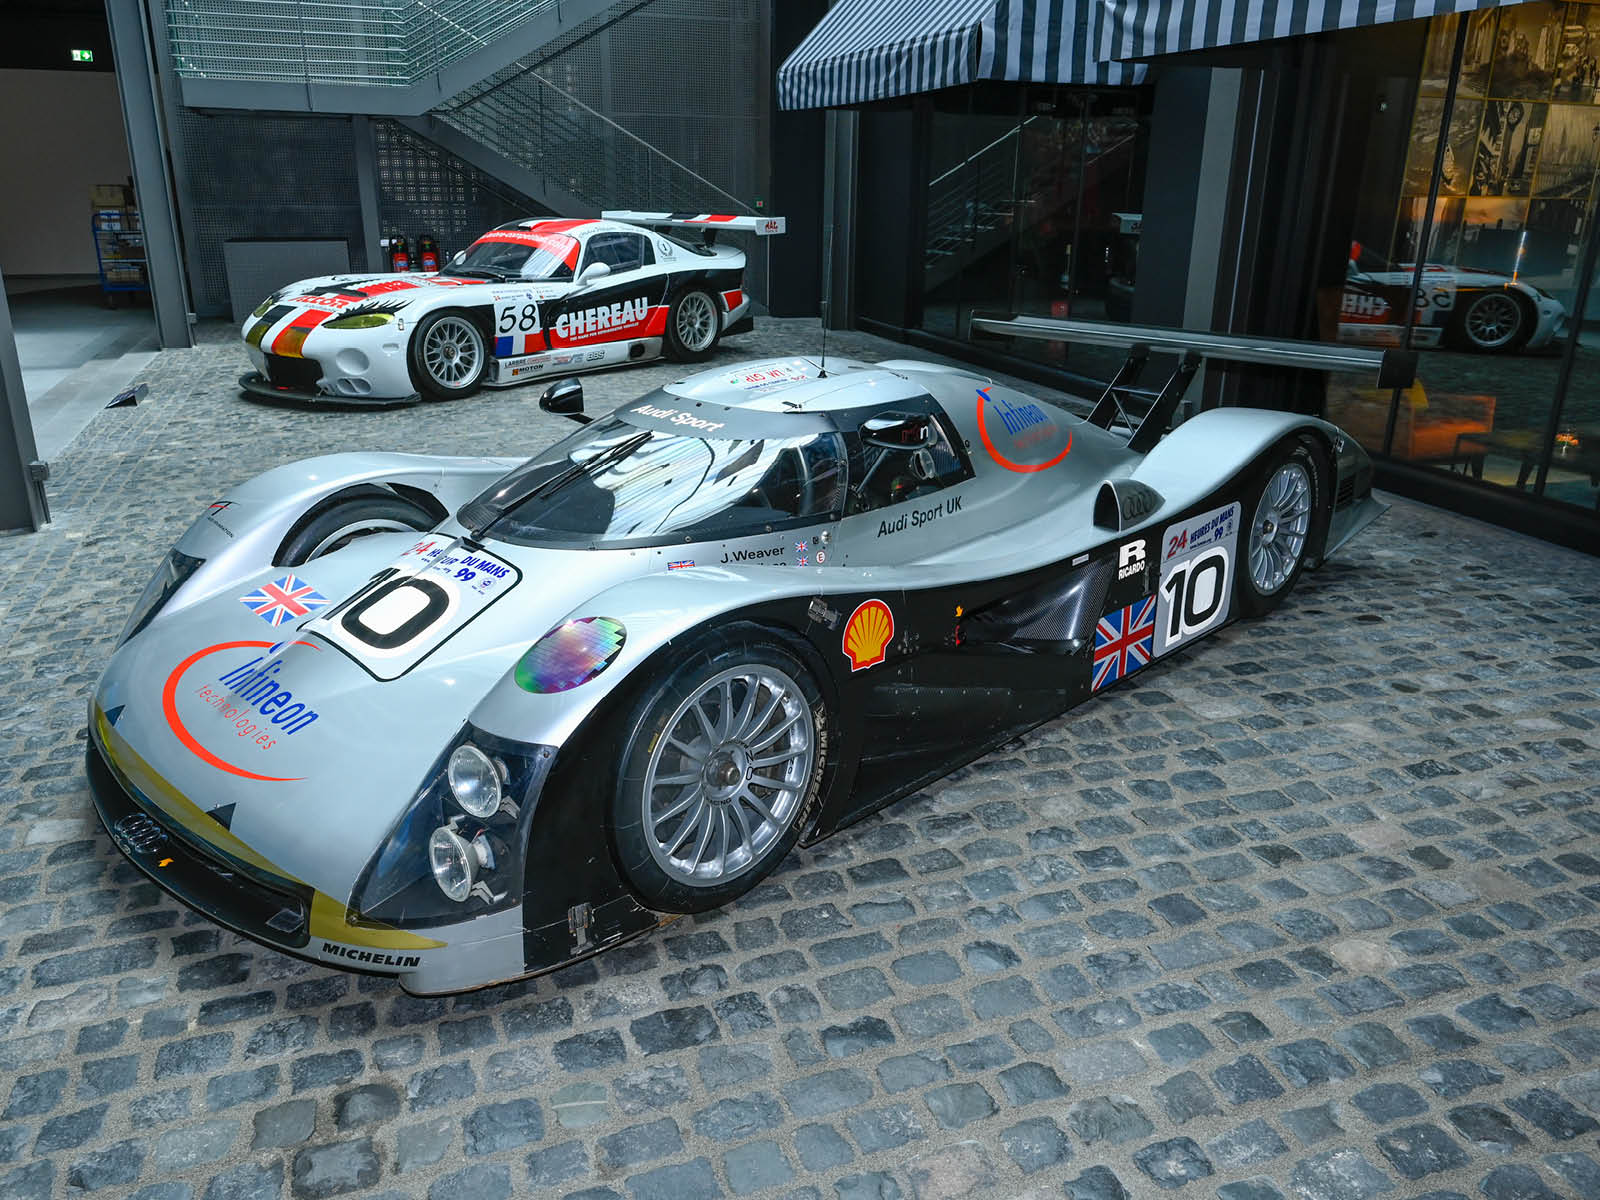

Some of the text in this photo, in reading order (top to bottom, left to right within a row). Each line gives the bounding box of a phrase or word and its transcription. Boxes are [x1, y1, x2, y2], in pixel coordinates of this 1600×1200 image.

[498, 303, 537, 334] 58
[555, 296, 649, 339] CHEREAU
[519, 364, 544, 373] MOTON
[629, 404, 725, 433] Audi Sport
[877, 495, 962, 538] Audi Sport UK
[1167, 529, 1188, 559] 24
[1190, 521, 1211, 544] HEURES
[1211, 516, 1220, 530] DU
[1218, 505, 1235, 524] MANS
[1214, 527, 1224, 541] 99
[459, 555, 481, 567] DU
[474, 560, 511, 579] MANS
[1118, 539, 1147, 568] R
[453, 567, 477, 582] 99
[1117, 562, 1146, 581] RICARDO
[320, 567, 450, 650] 10
[1164, 553, 1226, 638] 10
[218, 656, 320, 736] Infineon
[798, 731, 828, 829] MICHELIN
[322, 942, 421, 968] MICHELIN
